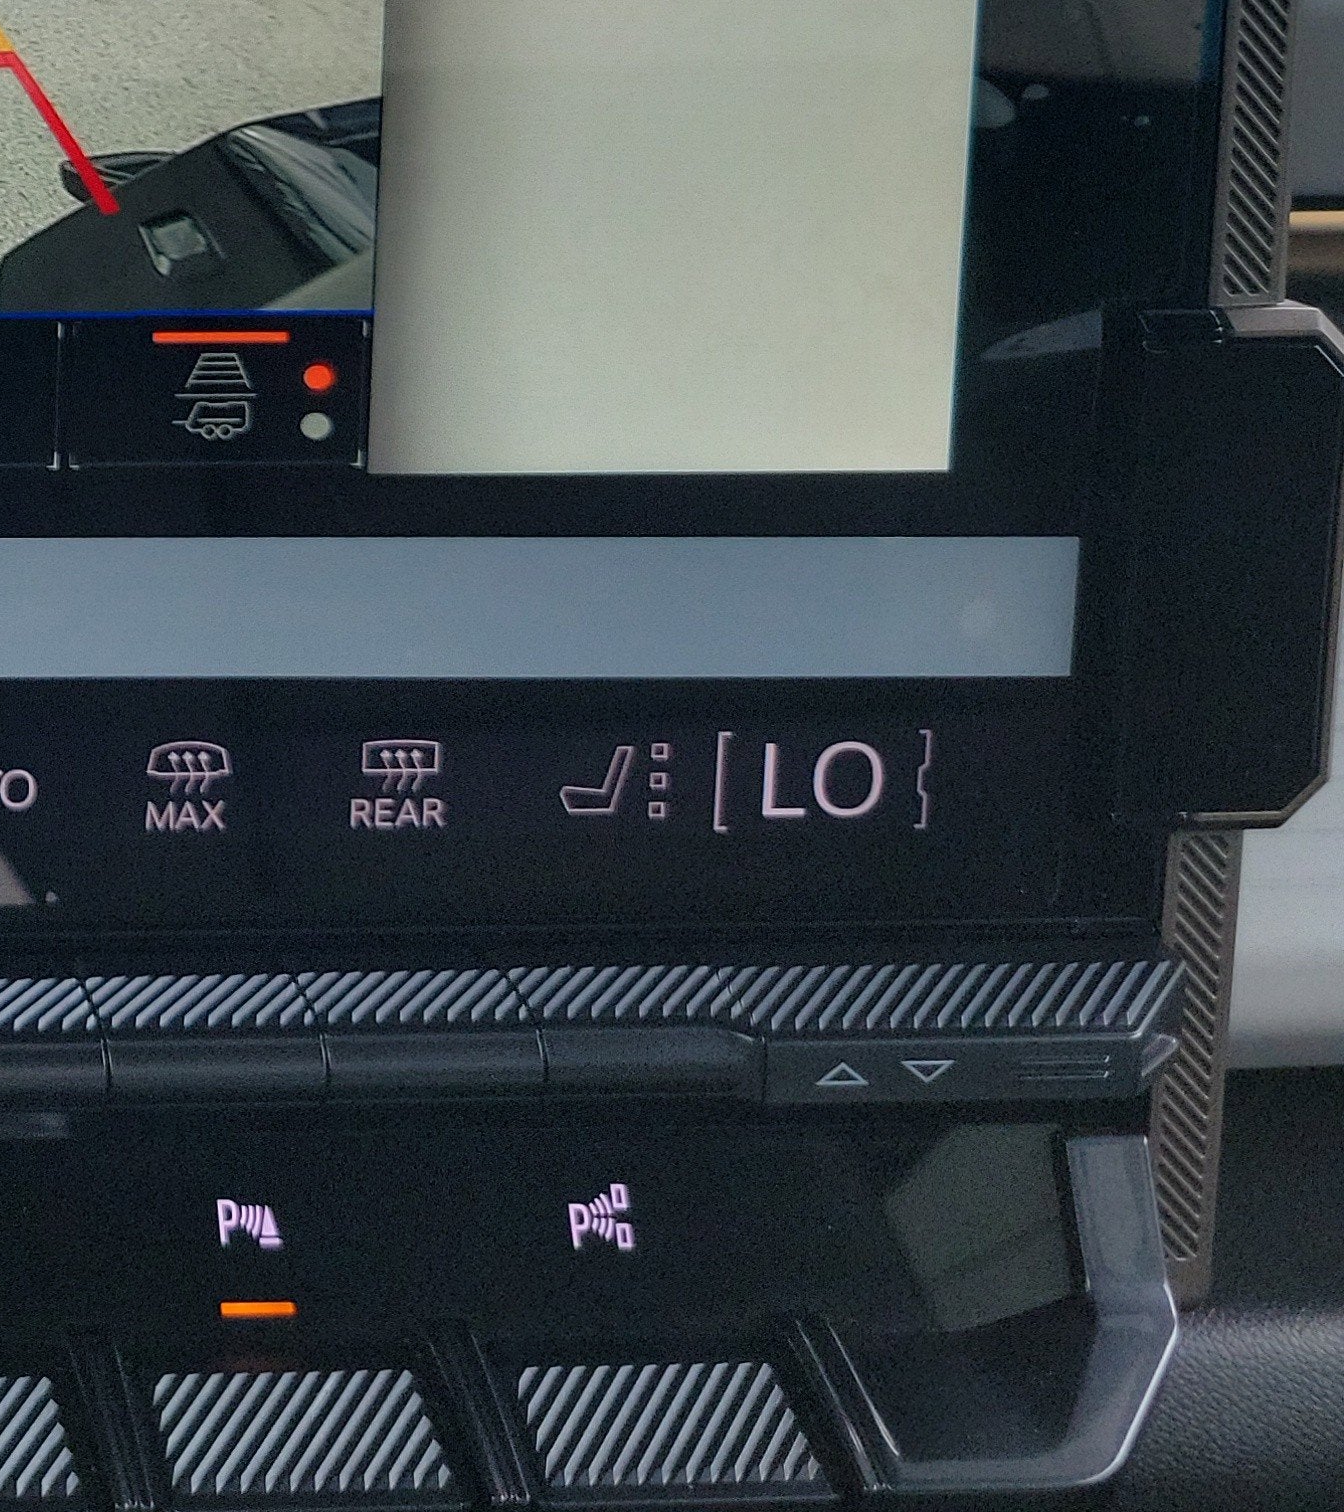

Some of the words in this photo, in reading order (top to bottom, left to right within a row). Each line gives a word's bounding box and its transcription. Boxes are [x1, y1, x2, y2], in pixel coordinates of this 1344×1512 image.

[762, 740, 884, 819] LO
[144, 800, 226, 832] MAX
[349, 798, 445, 829] REAR
